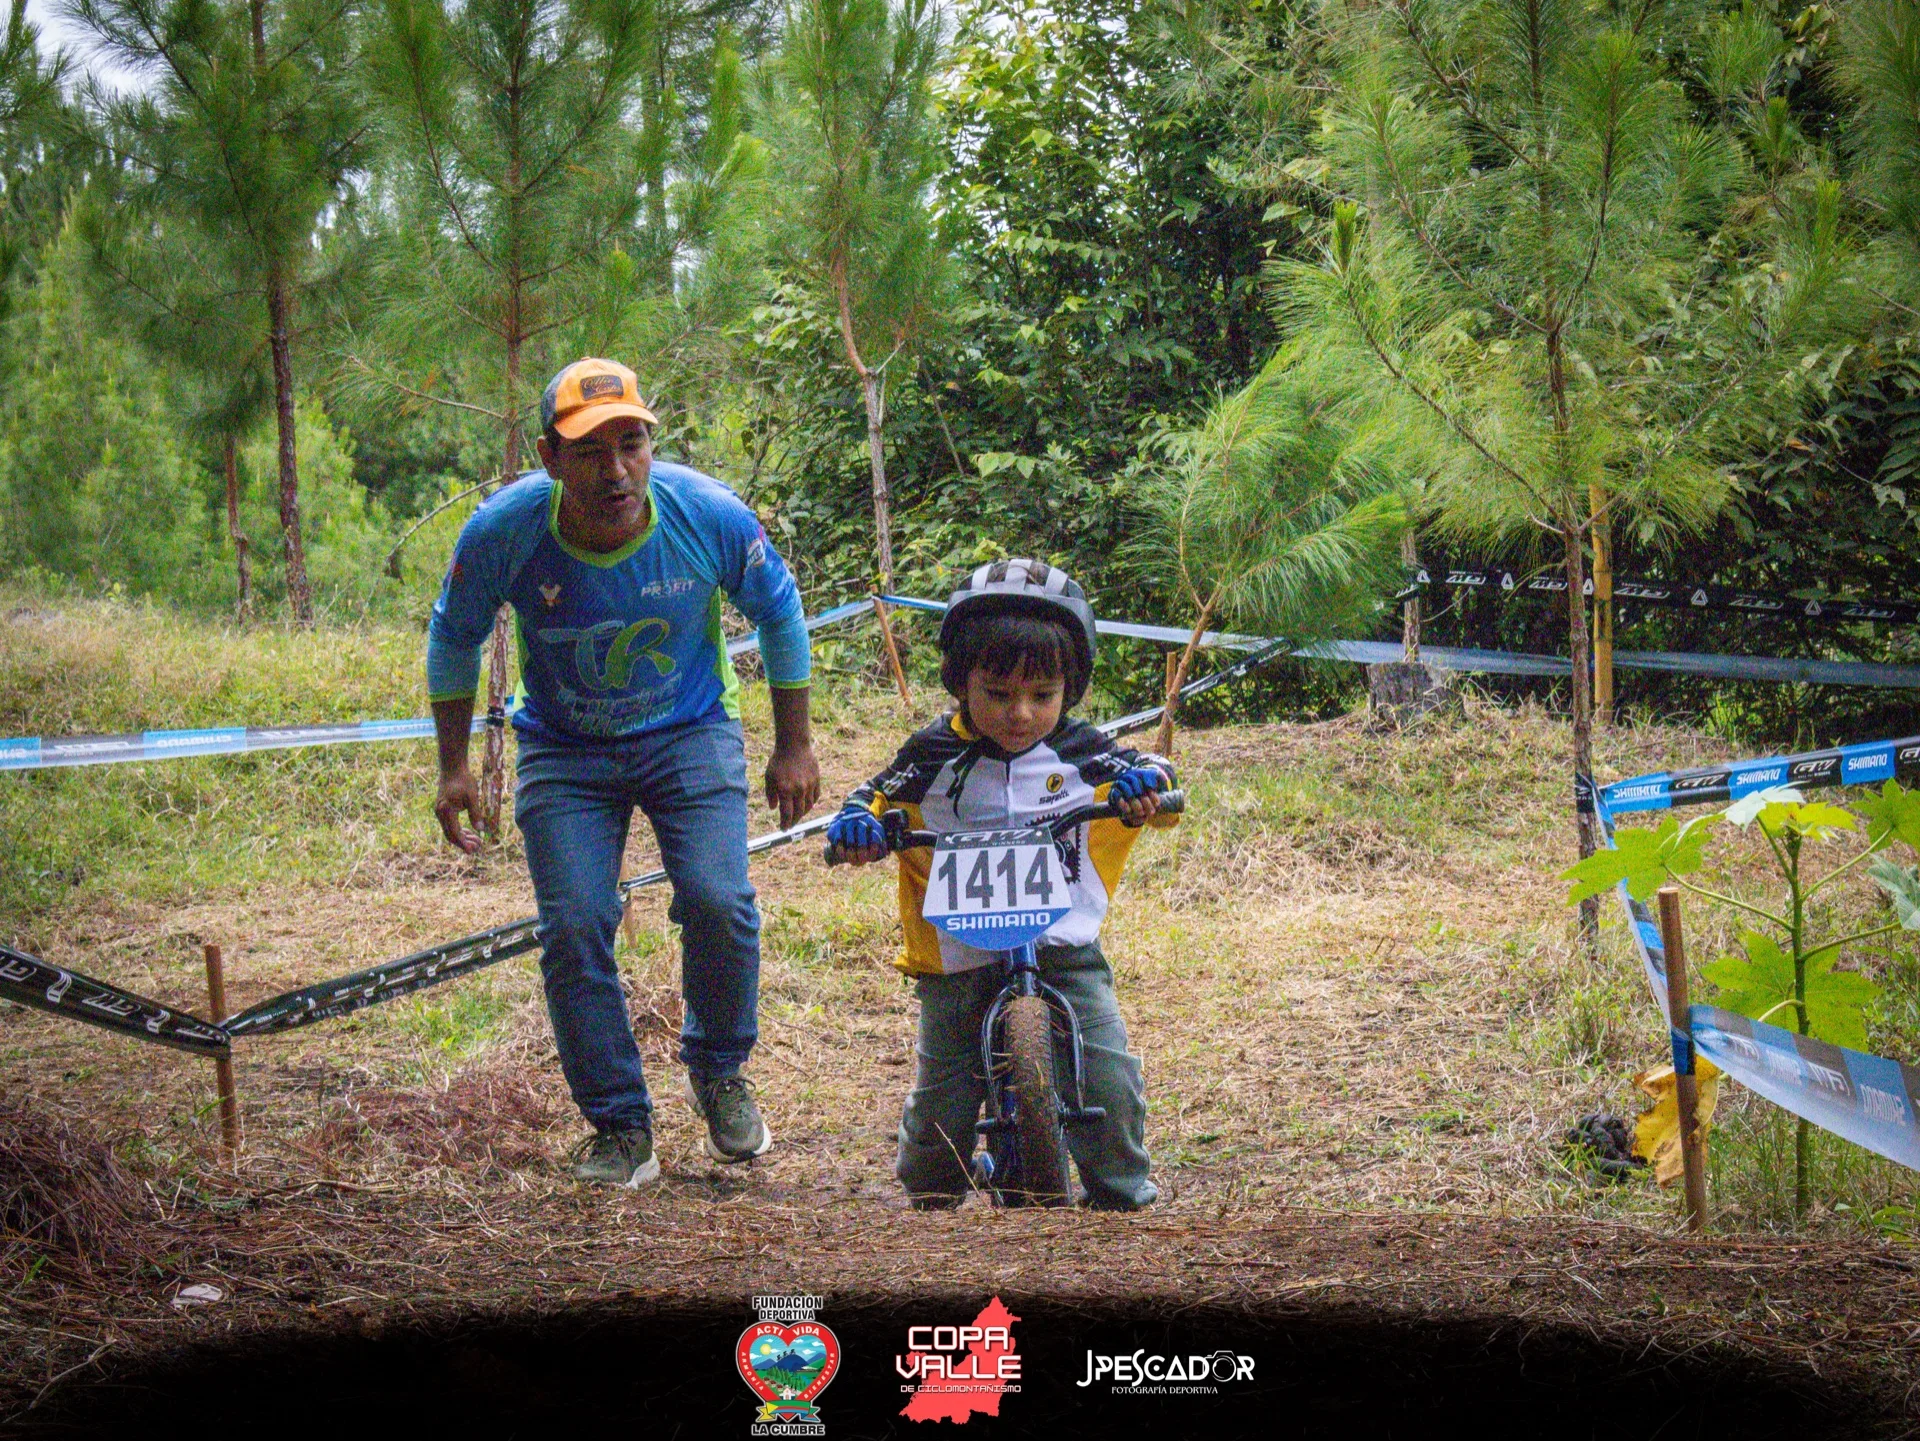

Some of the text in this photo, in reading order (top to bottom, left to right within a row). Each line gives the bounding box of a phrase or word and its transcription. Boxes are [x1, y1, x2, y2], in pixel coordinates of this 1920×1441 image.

[1848, 753, 1888, 771] SHIMANO
[1736, 768, 1781, 786] SHIMANO
[938, 846, 1054, 911] 1414
[946, 912, 1051, 931] SHIMANO
